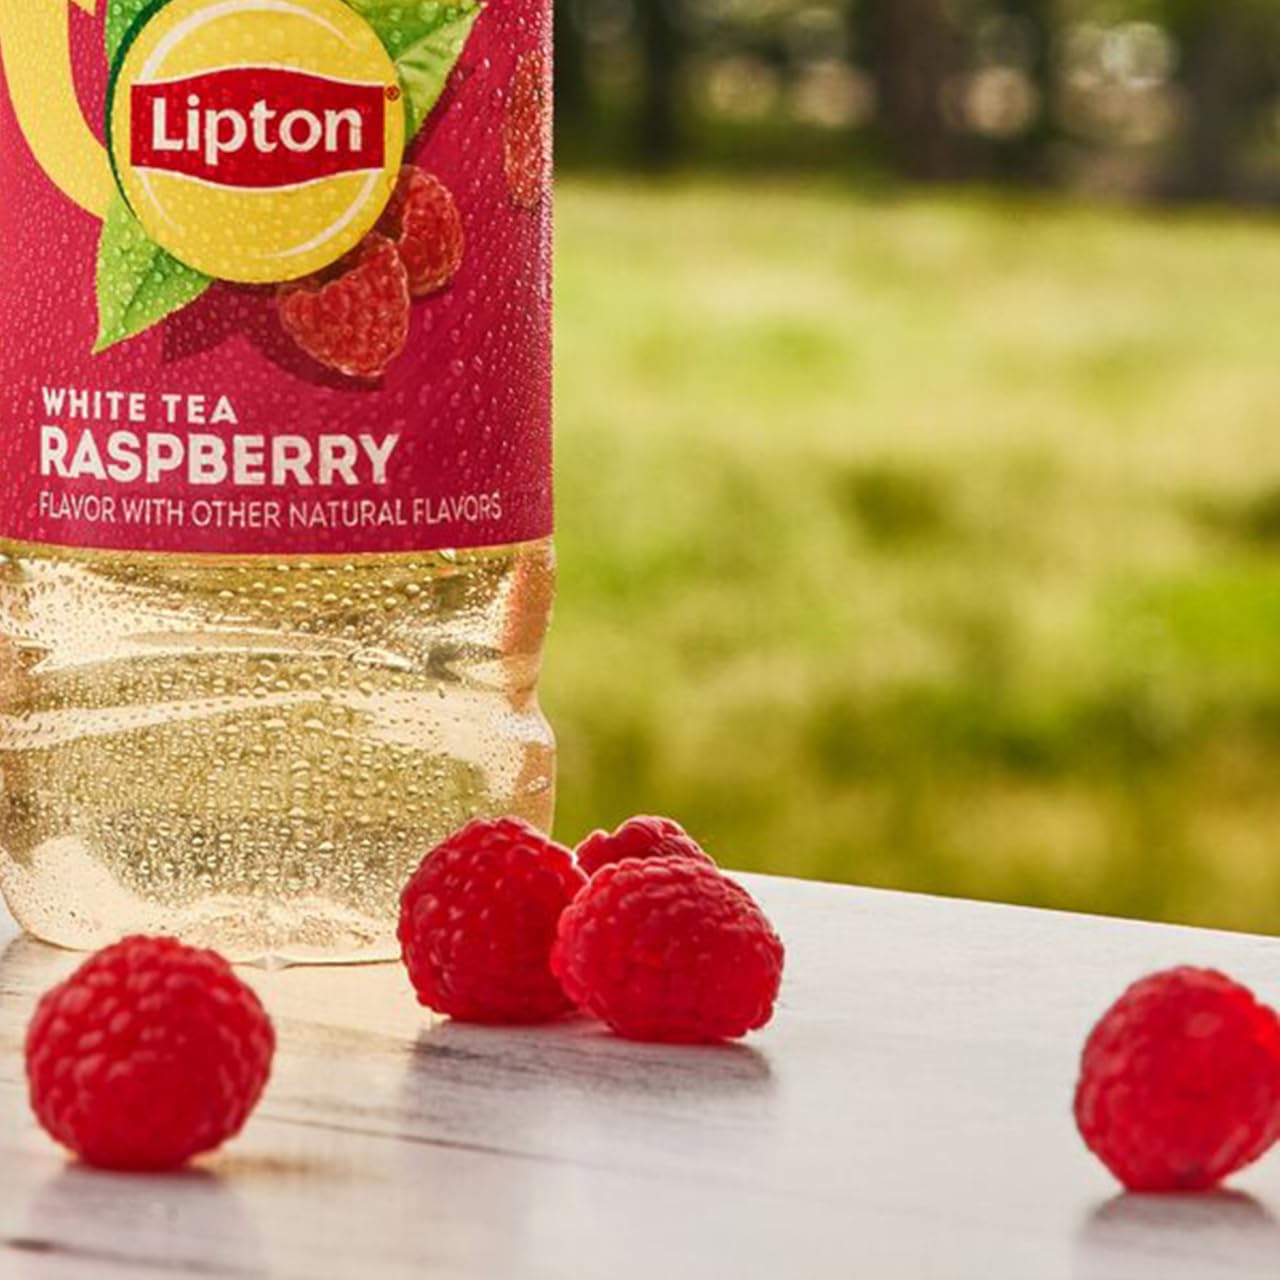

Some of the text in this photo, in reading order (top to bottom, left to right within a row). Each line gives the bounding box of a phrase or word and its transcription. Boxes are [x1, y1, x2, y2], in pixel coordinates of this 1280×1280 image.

[152, 94, 363, 166] Lipton
[41, 387, 238, 424] WHITE TEA
[39, 425, 399, 486] RASPBERRY
[39, 491, 503, 528] FLAVOR WITH OTHER NATURAL FLAVORS
